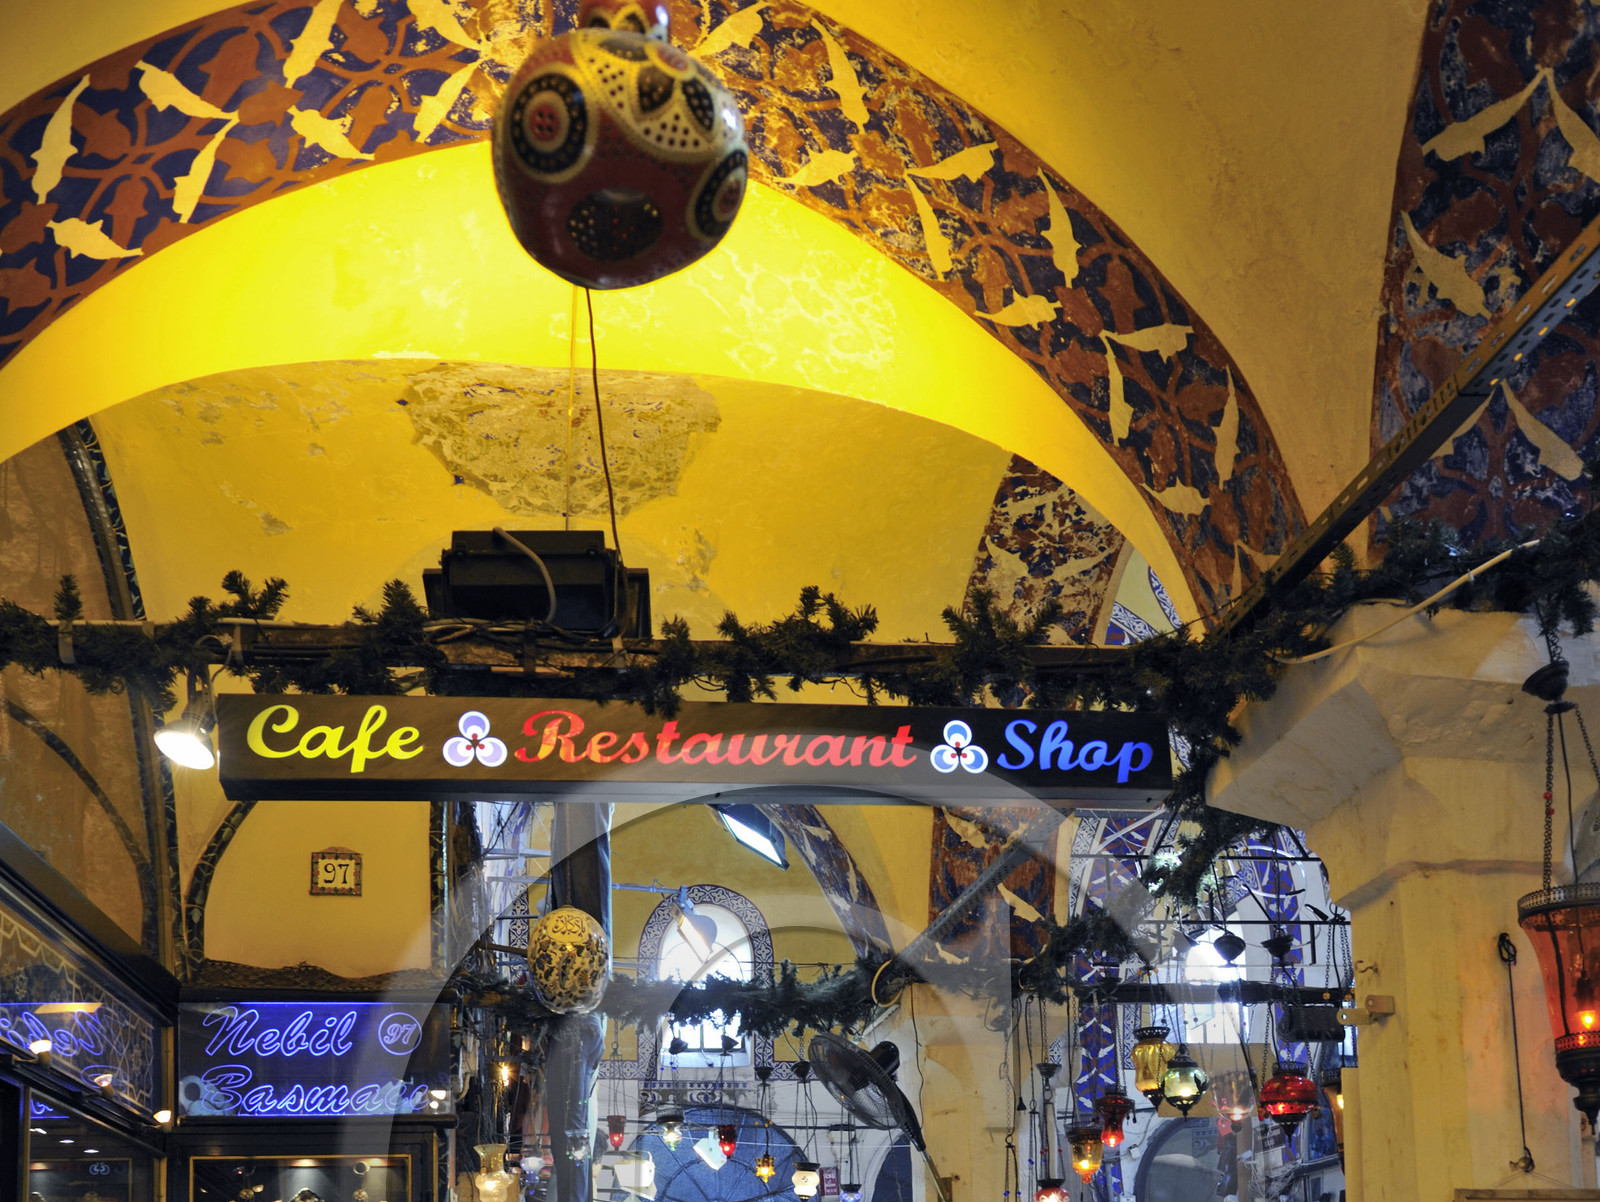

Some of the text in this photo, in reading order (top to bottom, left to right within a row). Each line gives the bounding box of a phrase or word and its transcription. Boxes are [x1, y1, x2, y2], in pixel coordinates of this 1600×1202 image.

[247, 704, 1154, 784] Cafe Restaurant Shop
[323, 862, 350, 885] 97
[203, 1005, 417, 1056] Nebil 97
